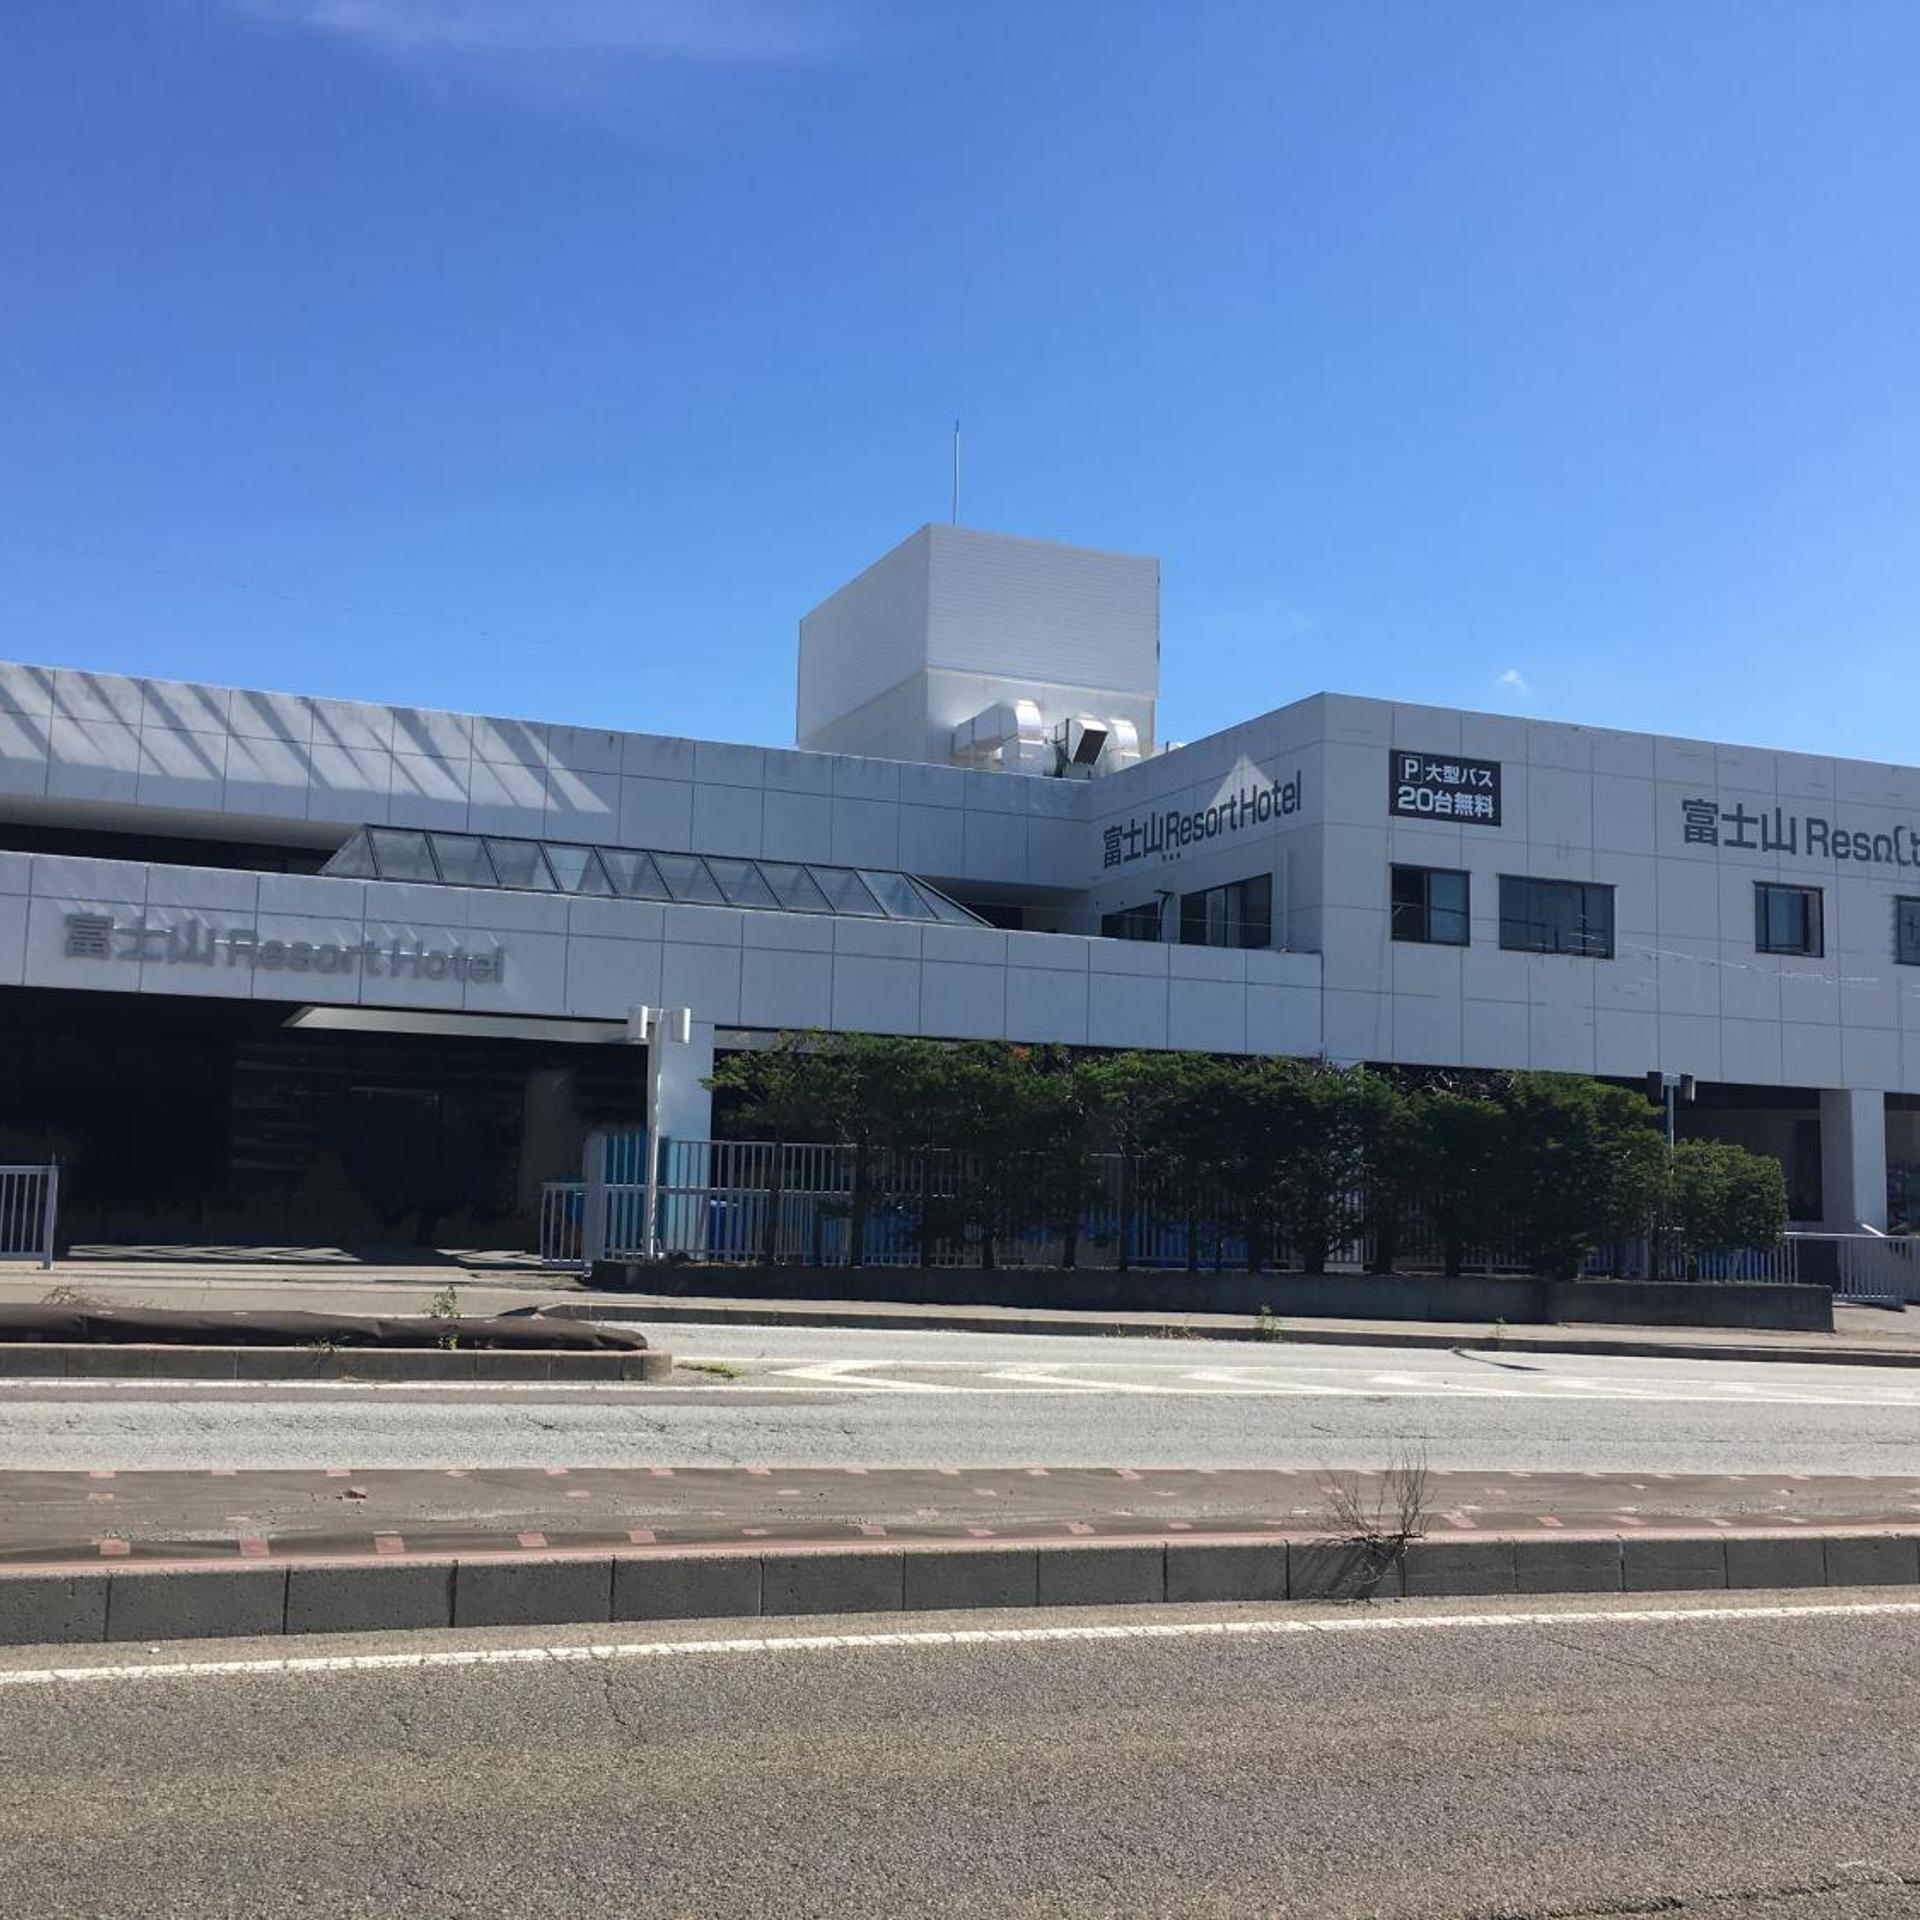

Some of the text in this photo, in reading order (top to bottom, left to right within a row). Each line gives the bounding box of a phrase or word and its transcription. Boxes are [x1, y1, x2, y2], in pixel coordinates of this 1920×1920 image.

[1404, 758, 1494, 787] P 大型バス
[1103, 769, 1302, 869] 富士山 Resort Hotel
[1397, 785, 1494, 818] 20台無料
[1681, 798, 1797, 855] 富士山
[65, 912, 504, 984] 富士山 Resort Hotel
